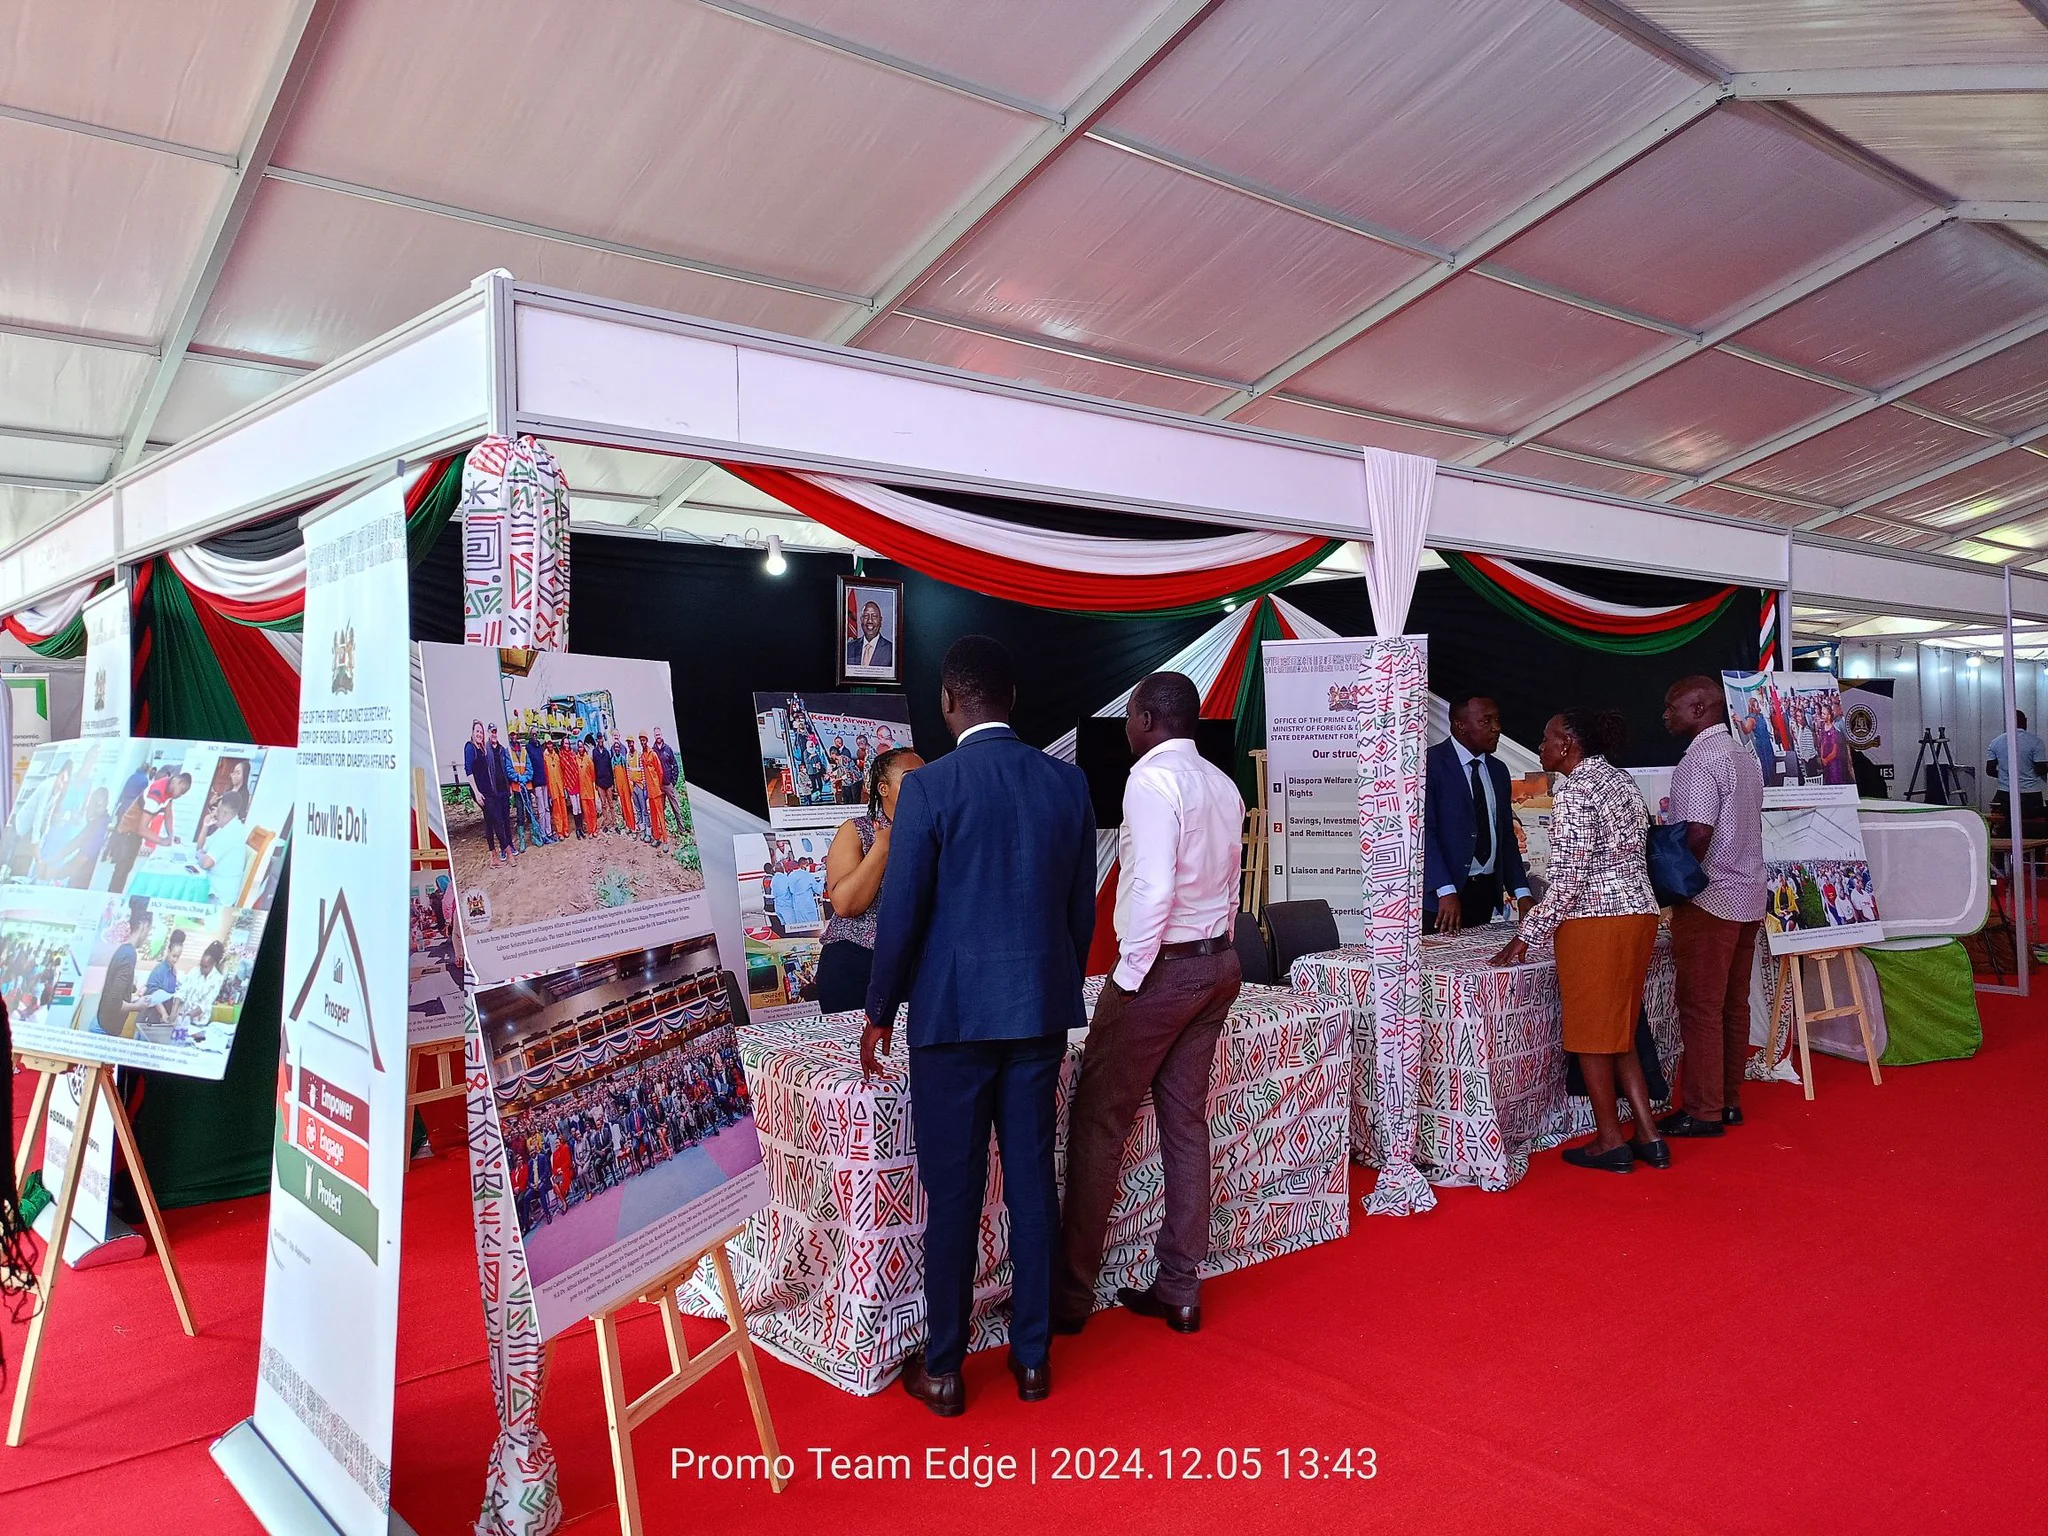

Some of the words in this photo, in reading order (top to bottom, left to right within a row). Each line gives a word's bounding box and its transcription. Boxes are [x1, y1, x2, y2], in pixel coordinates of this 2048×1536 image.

[341, 708, 363, 722] CABINET
[811, 714, 840, 722] Kenya
[842, 717, 876, 726] Airways
[1274, 717, 1297, 725] OFFICE
[1316, 724, 1346, 732] FOREIGN
[320, 730, 340, 744] FOREIGN
[342, 730, 346, 744] &
[1312, 749, 1330, 759] Our
[1332, 749, 1358, 758] struc
[302, 752, 335, 768] DEPARTMENT
[336, 753, 346, 768] FOR
[371, 754, 396, 770] AFFAIRS
[1288, 776, 1322, 785] Diaspora
[1324, 776, 1353, 784] Welfare
[1289, 790, 1313, 798] Rights
[307, 802, 329, 837] How
[330, 804, 344, 840] We
[345, 805, 360, 844] Do
[361, 810, 368, 846] It
[1290, 816, 1321, 826] Savings,
[1291, 866, 1318, 874] Liaison
[325, 993, 350, 1027] Prosper
[321, 1083, 354, 1122] Empower
[320, 1127, 345, 1166] Engage
[318, 1178, 342, 1216] Protect
